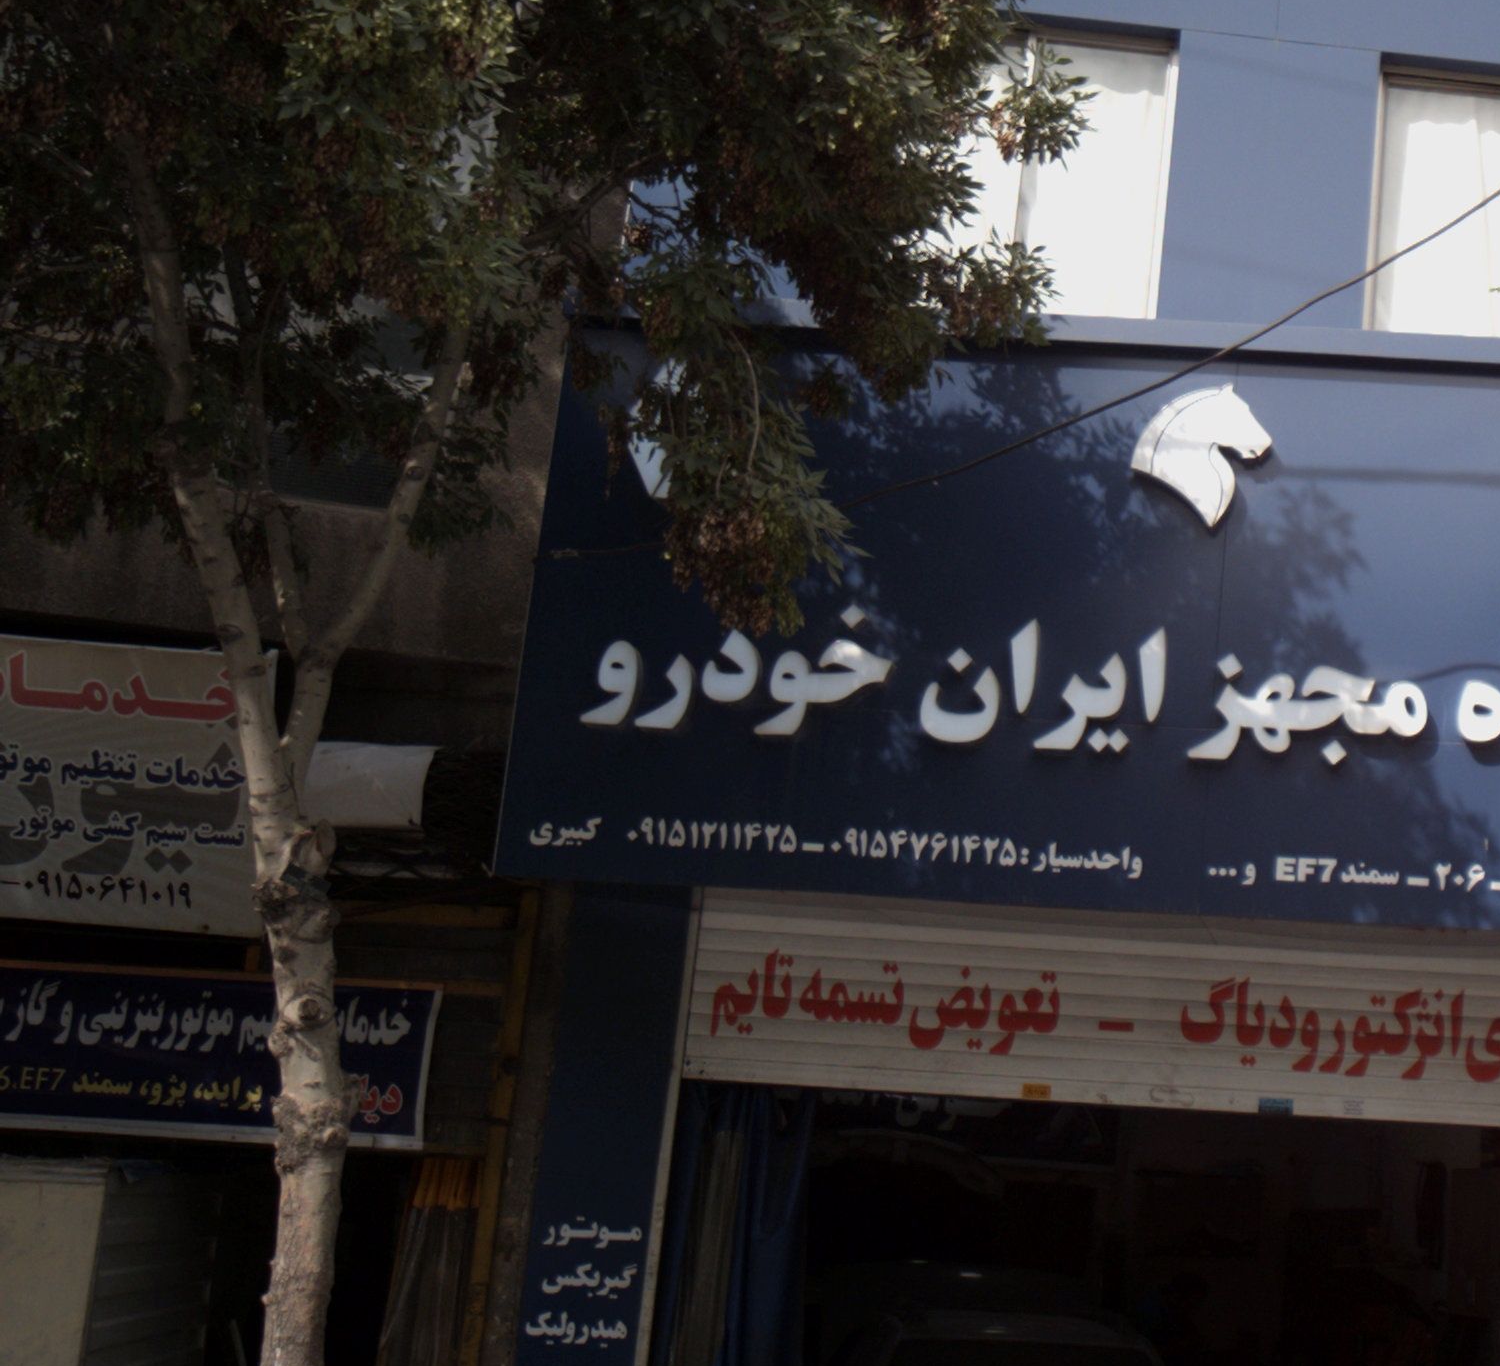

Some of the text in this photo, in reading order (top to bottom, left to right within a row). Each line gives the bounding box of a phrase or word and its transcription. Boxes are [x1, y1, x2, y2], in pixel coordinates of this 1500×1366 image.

[0, 650, 238, 721] خدما
[579, 604, 896, 735] خودرو
[920, 618, 1167, 752] ایران
[1187, 653, 1428, 766] مجهز
[61, 750, 137, 785] تنظیم
[146, 756, 246, 789] خدمات
[13, 808, 244, 847] تست سیم کشی موتور
[529, 817, 602, 847] کبیری
[1275, 856, 1337, 884] EF7
[1340, 862, 1400, 886] سمند
[1435, 863, 1486, 892] ۲۰۶
[3, 979, 61, 1042] گاز
[710, 948, 795, 1036] تایم
[799, 961, 905, 1026] تسمه
[908, 966, 1060, 1055] تعویض
[72, 1072, 133, 1095] سمند
[542, 1215, 643, 1249] موتور
[541, 1263, 639, 1300] گیربکس
[525, 1311, 628, 1349] هیدرولیک
